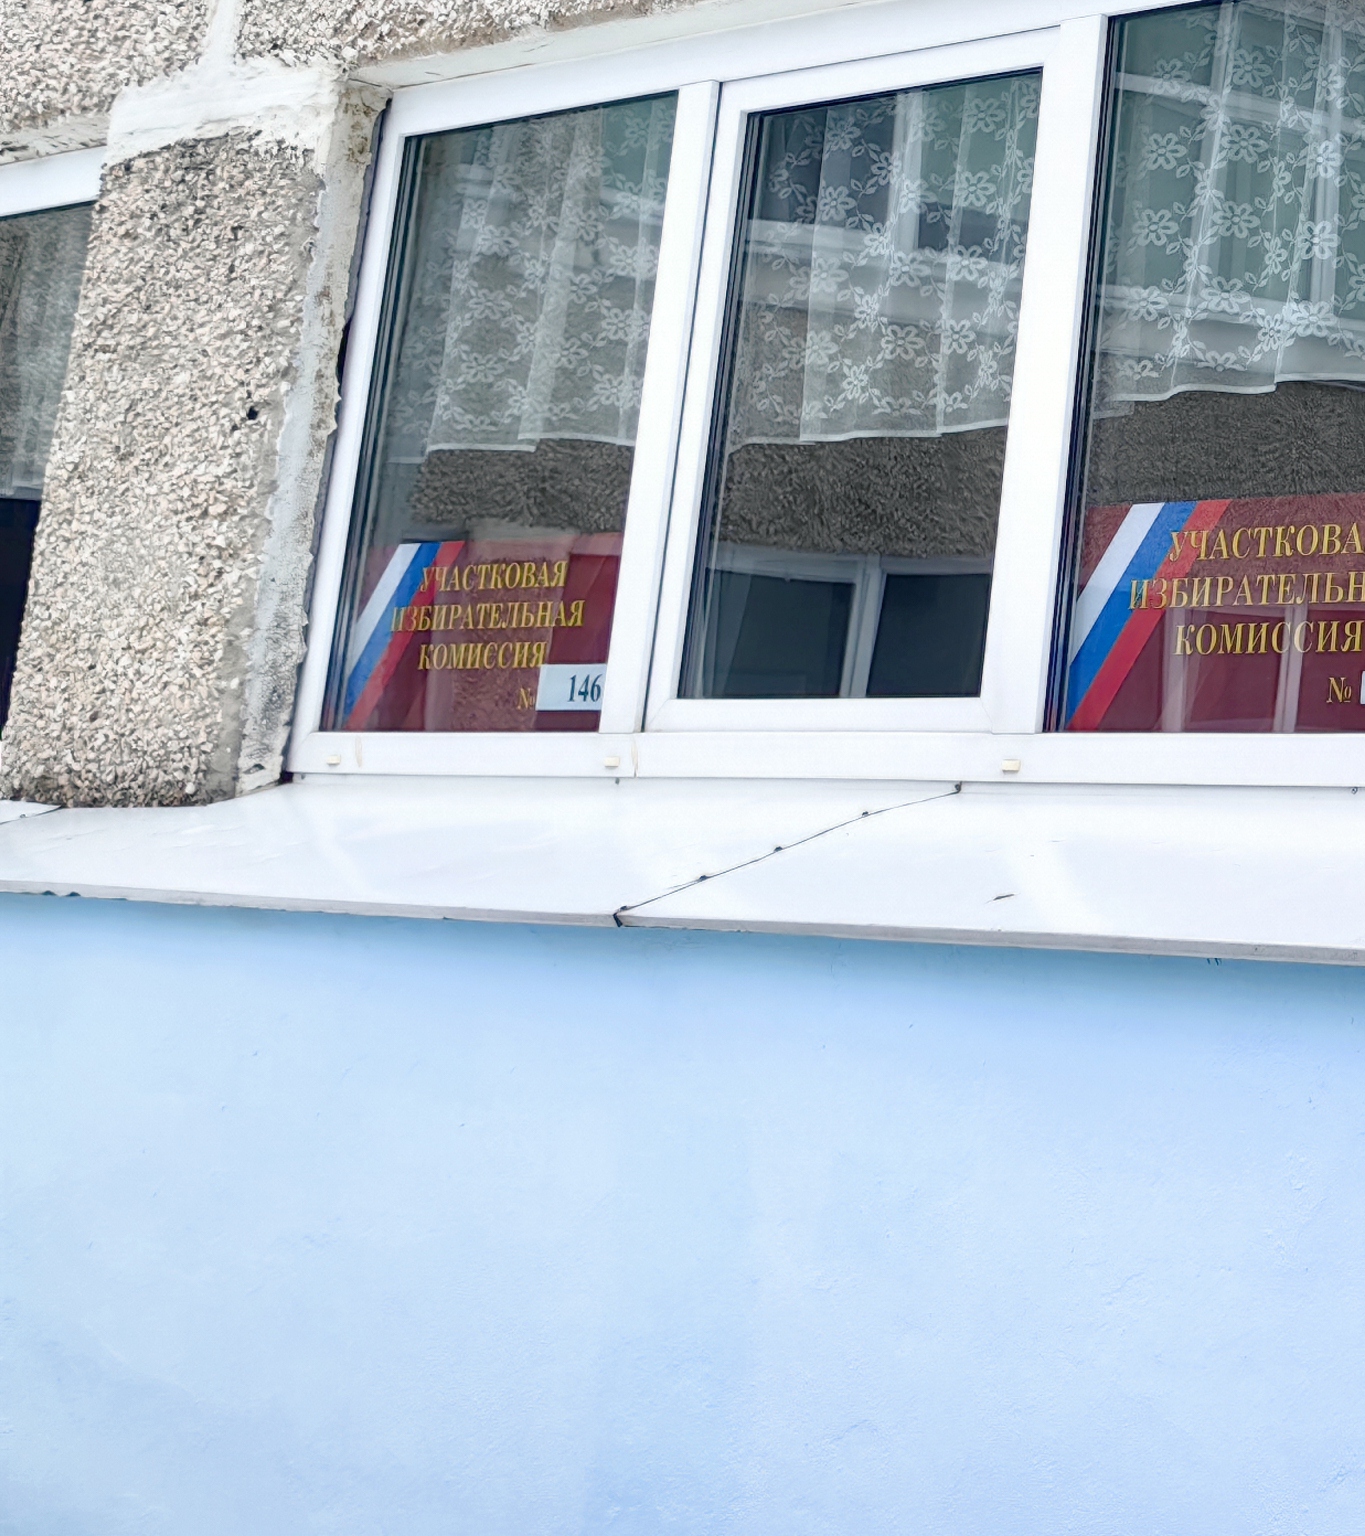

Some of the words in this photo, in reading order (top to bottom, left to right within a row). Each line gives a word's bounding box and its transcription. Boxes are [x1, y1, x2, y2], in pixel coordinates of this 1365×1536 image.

[420, 560, 568, 592] УЧАСТКОВАЯ
[390, 600, 585, 632] ИЗБИРАТЕЛЬНАЯ
[1173, 620, 1364, 656] КОМИССИЯ
[418, 641, 548, 670] КОМИССИЯ
[567, 674, 602, 702] 146
[1326, 677, 1352, 704] №
